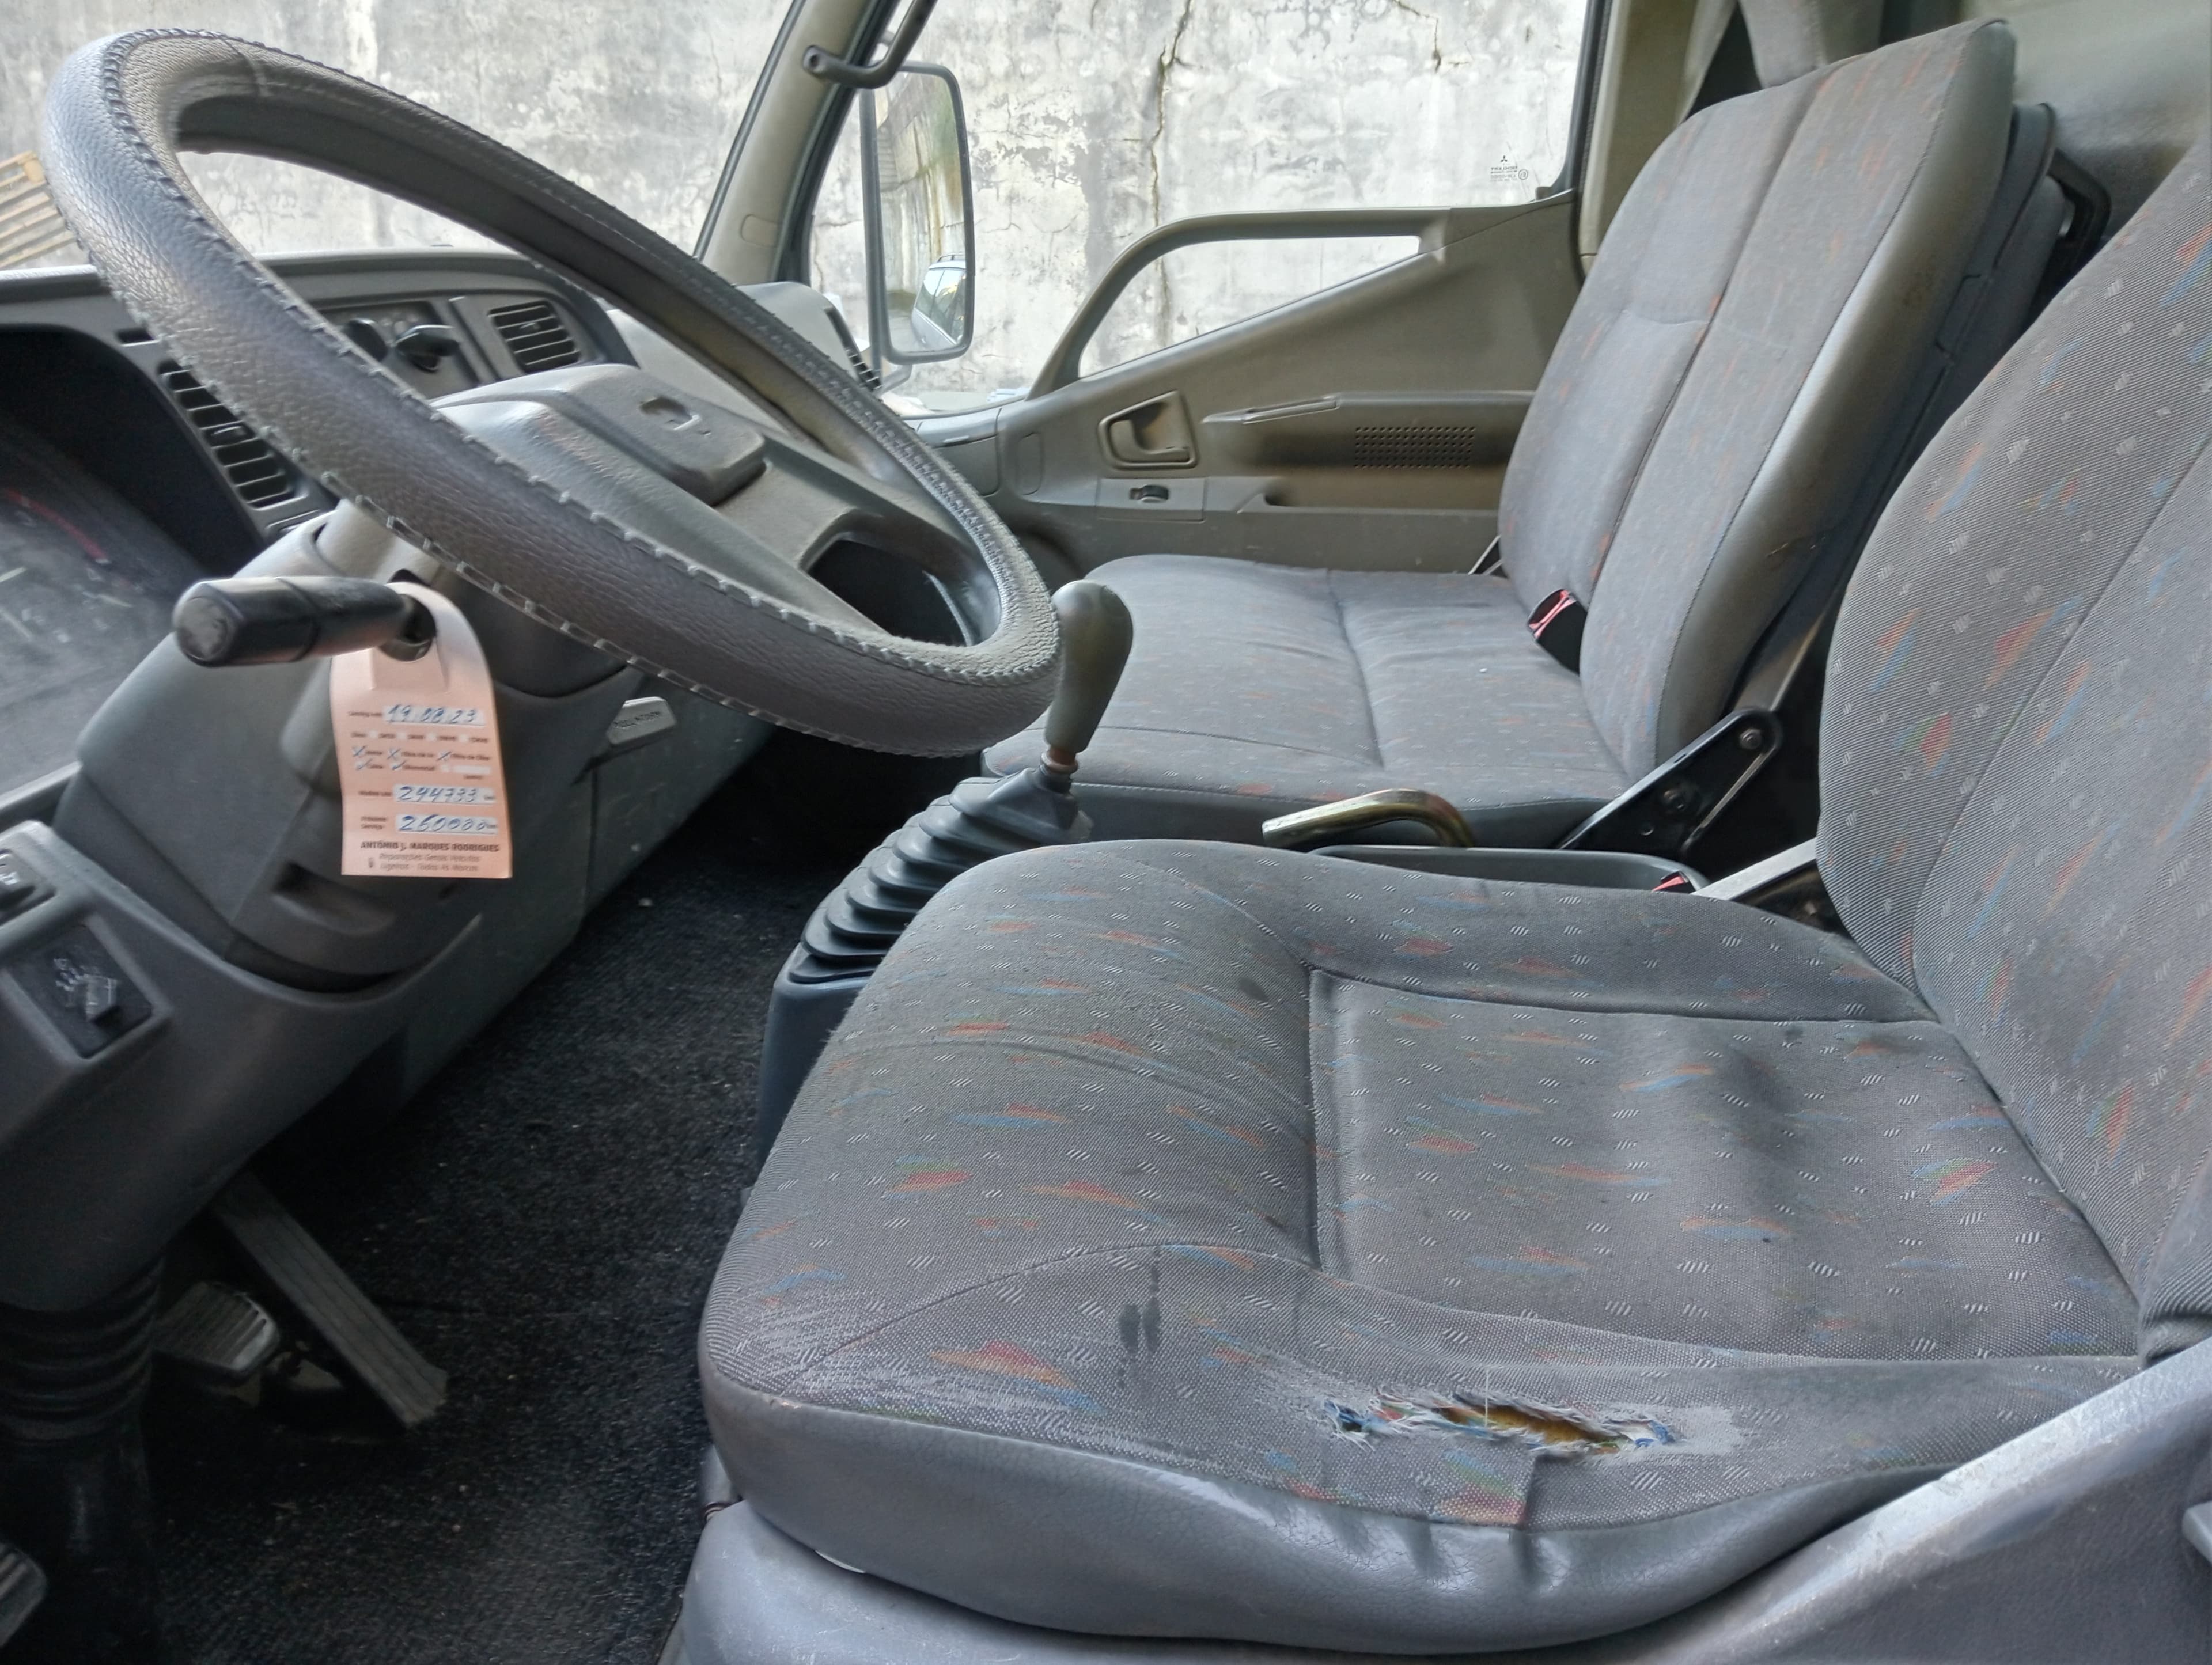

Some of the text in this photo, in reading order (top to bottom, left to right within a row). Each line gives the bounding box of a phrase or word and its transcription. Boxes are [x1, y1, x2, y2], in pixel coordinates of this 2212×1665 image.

[361, 840, 399, 849] ANTÓNIO
[409, 842, 450, 851] MARQUES
[452, 843, 501, 852] RODRIGUES
